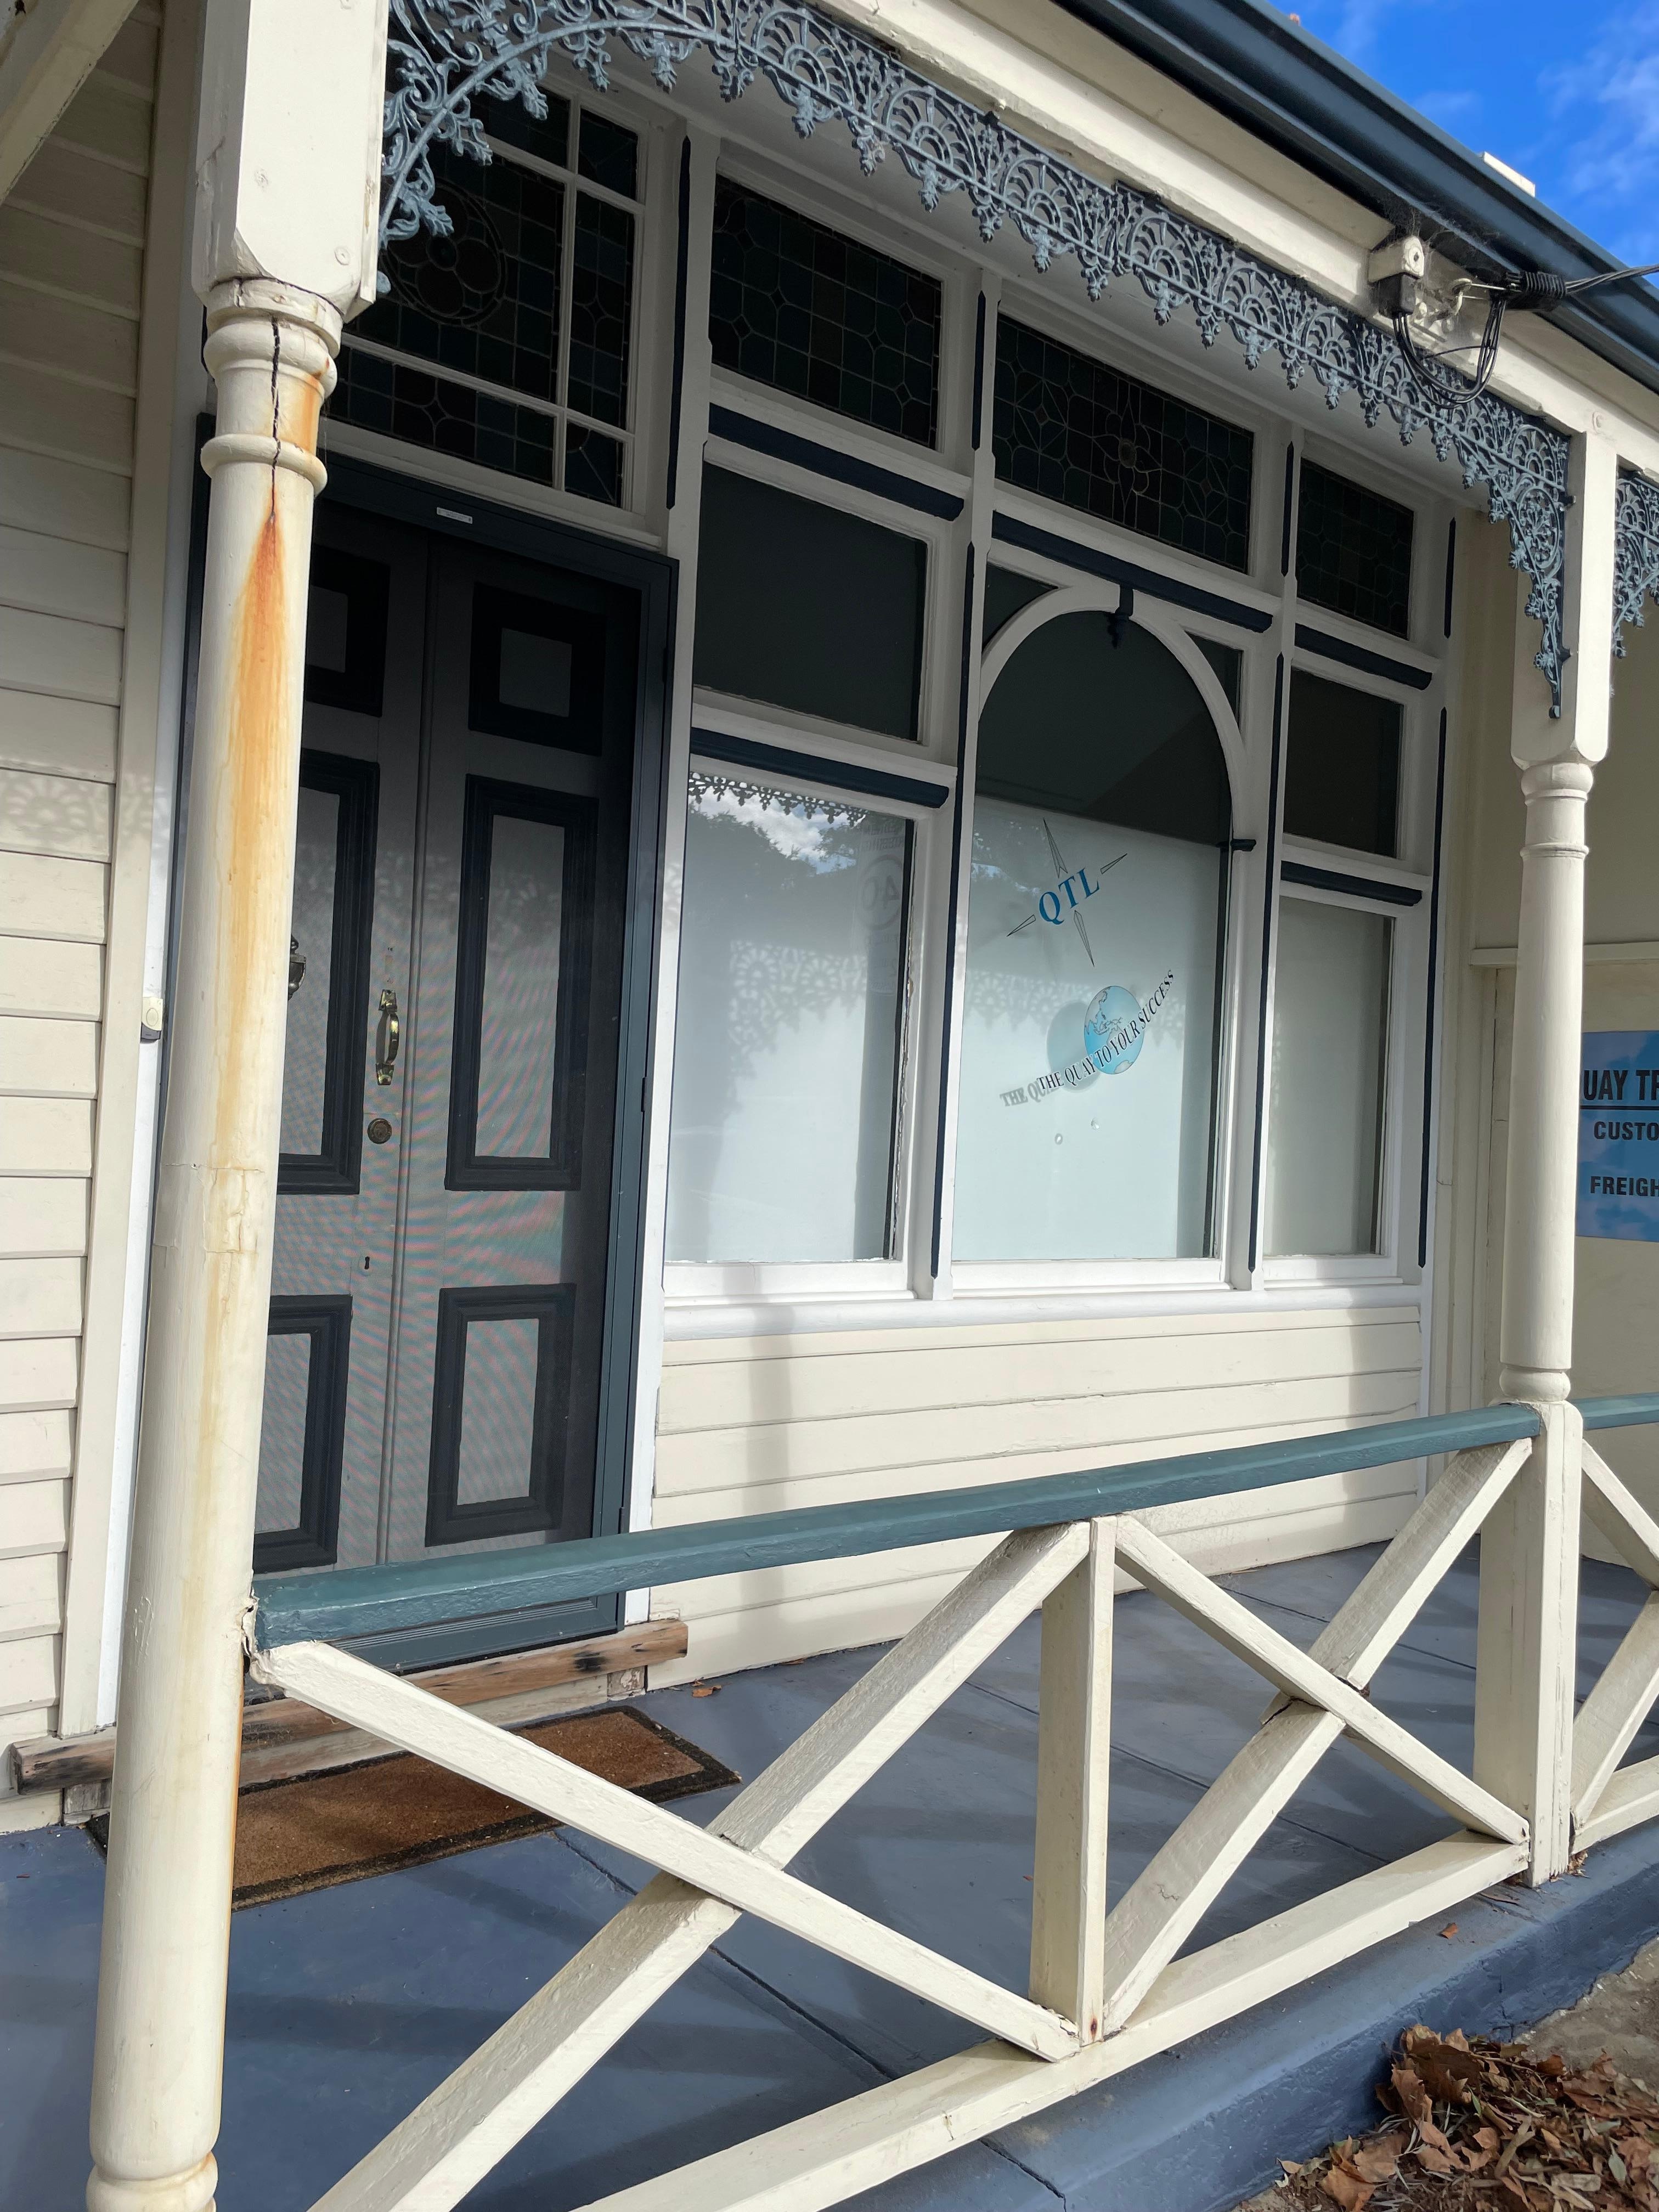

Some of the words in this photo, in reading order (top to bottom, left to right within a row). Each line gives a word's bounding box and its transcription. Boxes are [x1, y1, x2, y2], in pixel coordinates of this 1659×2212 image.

[1039, 868, 1099, 925] QTL
[1036, 1072, 1064, 1089] THE
[1065, 1054, 1096, 1086] QUAY
[1094, 1045, 1111, 1067] TO
[1110, 1020, 1141, 1056] YOUR
[1138, 970, 1173, 1029] SUCCESS
[1594, 1121, 1659, 1141] CUSTO
